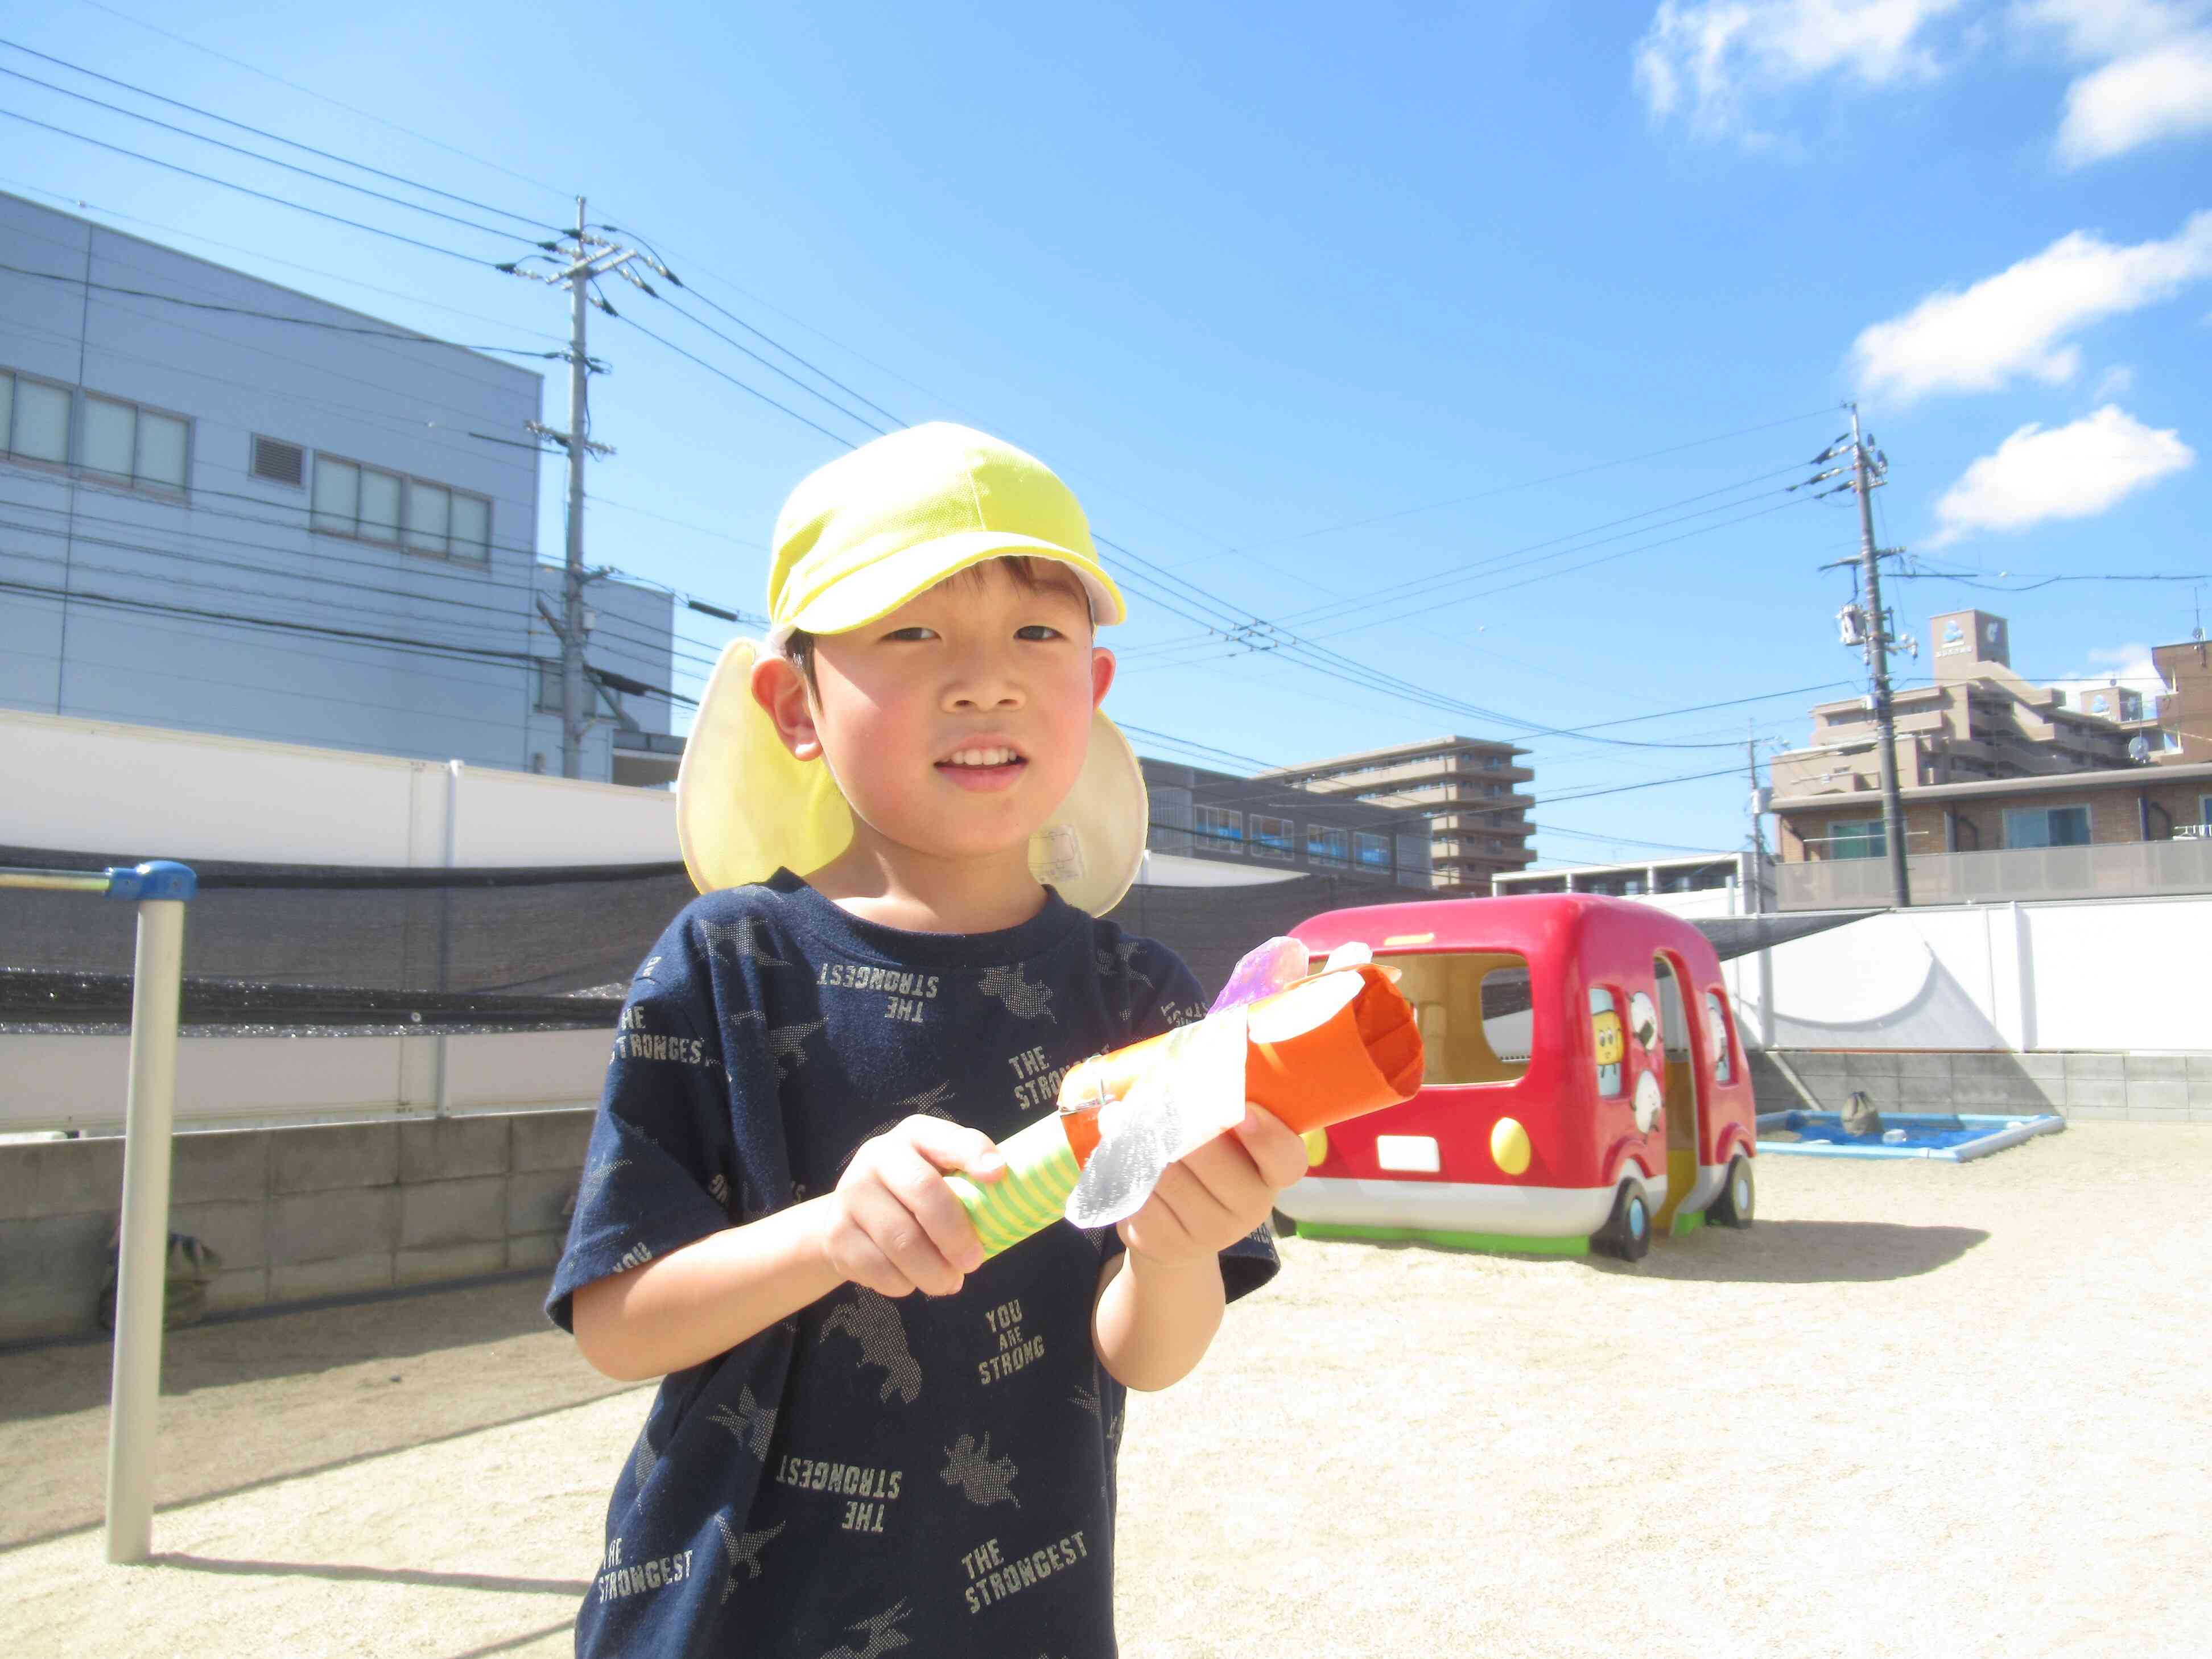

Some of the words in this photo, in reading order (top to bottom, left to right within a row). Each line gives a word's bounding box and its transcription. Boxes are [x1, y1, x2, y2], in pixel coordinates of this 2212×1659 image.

[817, 963, 939, 997] STRONGEST
[621, 1006, 646, 1030] HE
[884, 996, 924, 1023] THE
[1008, 1046, 1050, 1079] THE
[985, 1299, 1022, 1333] YOU
[1000, 1326, 1023, 1351] ARE
[978, 1335, 1045, 1384] STRONG
[775, 1454, 903, 1500] STRONGEST
[841, 1500, 886, 1532] THE
[961, 1537, 1005, 1580] THE
[964, 1530, 1088, 1614] STRONGEST
[599, 1549, 693, 1604] STRONGEST
